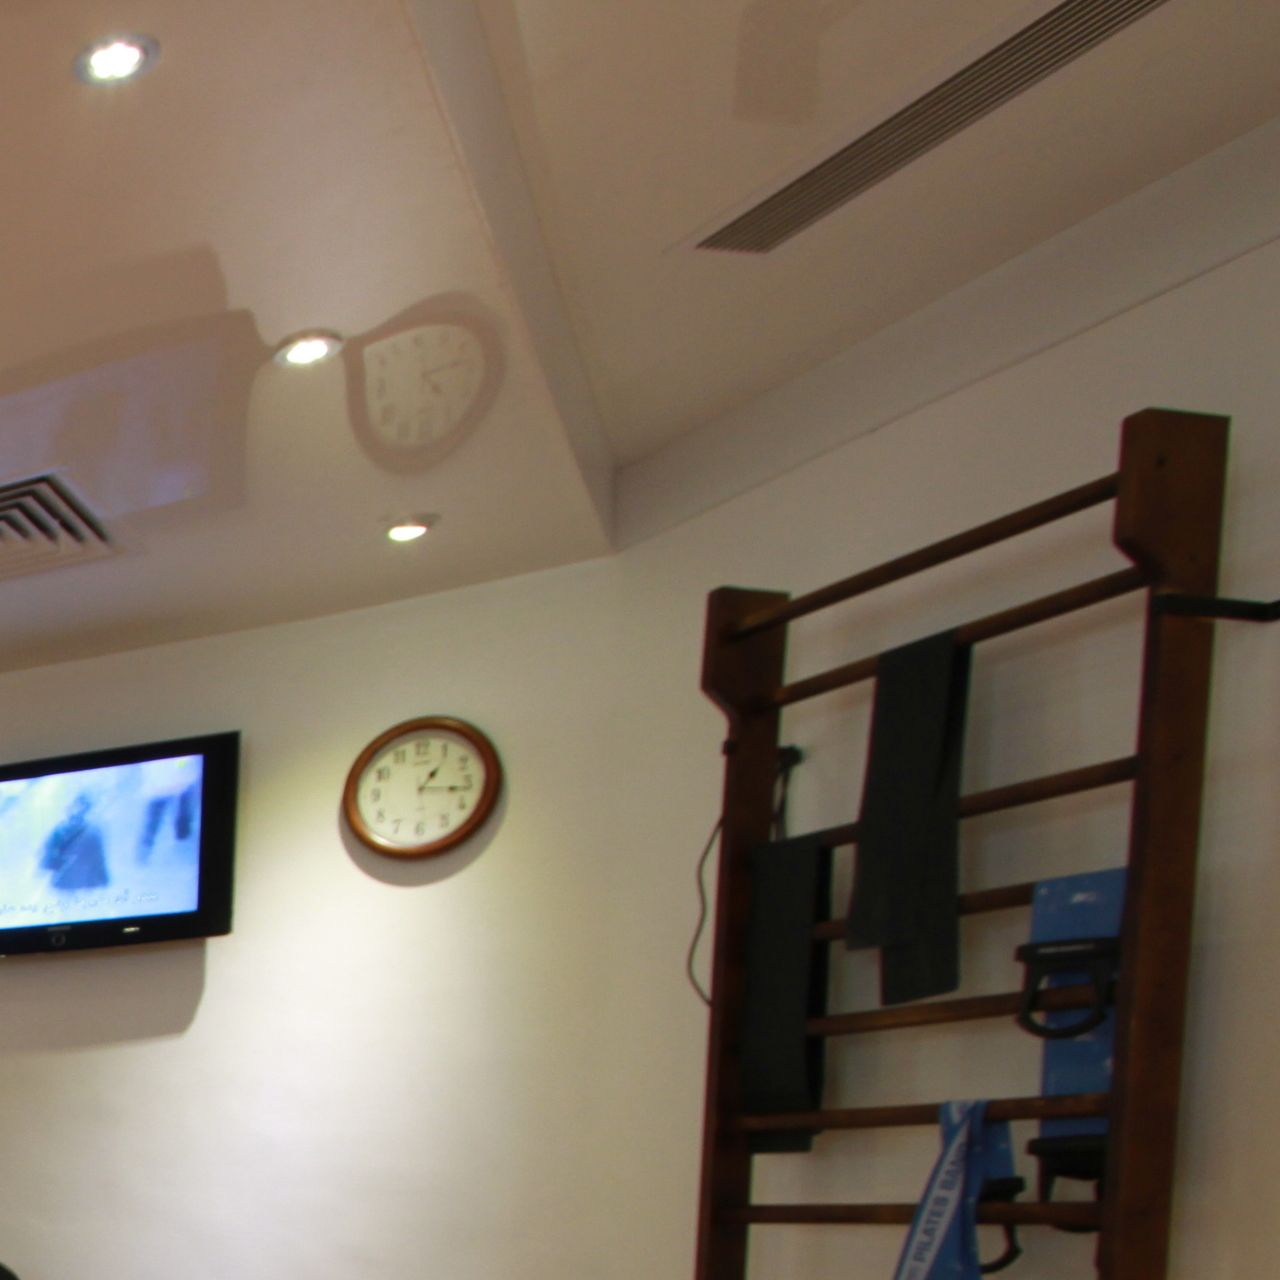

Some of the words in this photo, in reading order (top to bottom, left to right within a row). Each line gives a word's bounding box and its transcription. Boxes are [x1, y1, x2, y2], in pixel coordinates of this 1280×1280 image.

[393, 748, 406, 765] 11
[414, 740, 430, 757] 12
[458, 754, 470, 772] 2
[375, 765, 390, 783] 10
[391, 818, 403, 835] 7
[414, 821, 426, 836] 6
[914, 1195, 949, 1263] PILATES
